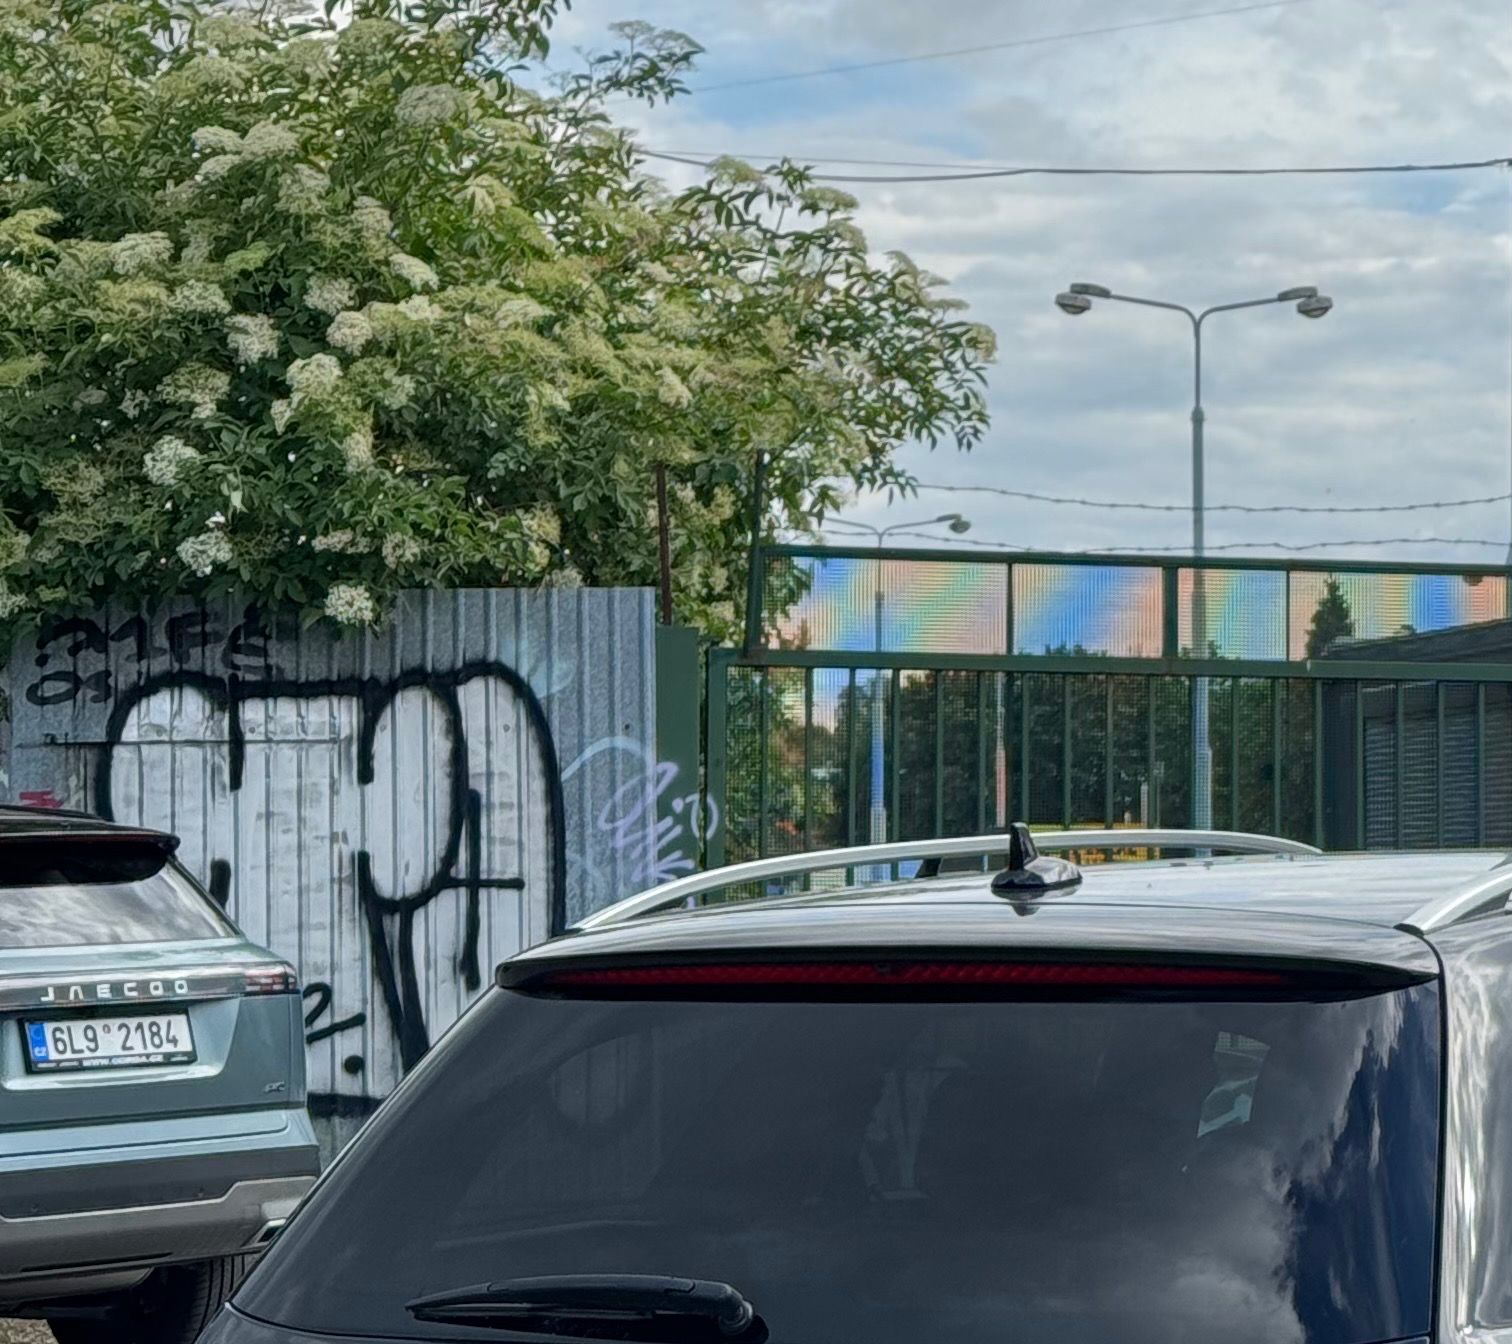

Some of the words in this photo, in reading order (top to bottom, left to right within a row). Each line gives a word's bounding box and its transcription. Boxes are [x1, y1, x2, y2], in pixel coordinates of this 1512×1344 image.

[39, 979, 189, 1002] JAECOO
[51, 1023, 101, 1055] 6L9
[117, 1019, 180, 1052] 2184
